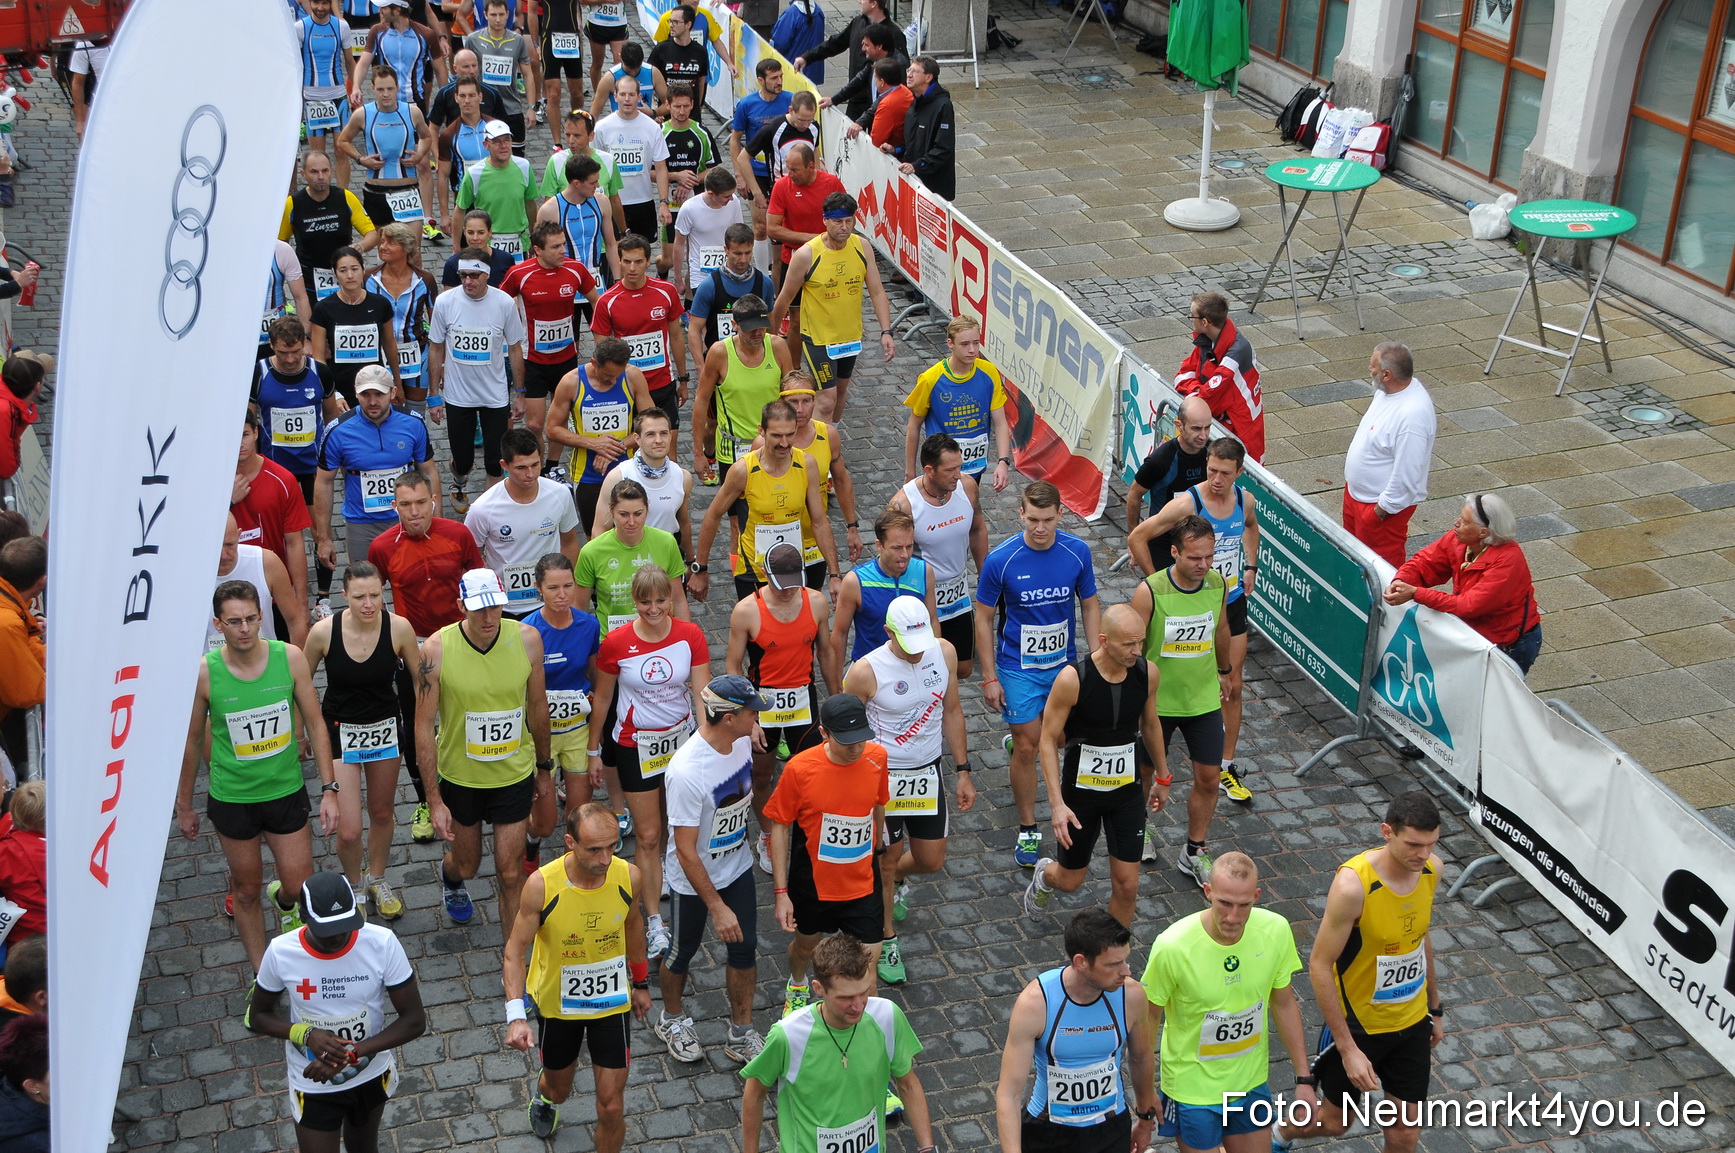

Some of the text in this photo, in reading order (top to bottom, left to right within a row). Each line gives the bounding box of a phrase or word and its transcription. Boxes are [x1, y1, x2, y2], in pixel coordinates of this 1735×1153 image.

[555, 38, 577, 48] 2059
[486, 62, 510, 74] 2707
[310, 106, 336, 118] 2028
[614, 152, 642, 164] 2005
[391, 197, 420, 212] 2042
[306, 222, 340, 232] Linzer
[340, 334, 375, 349] 2022
[539, 326, 570, 342] 2017
[454, 336, 490, 351] 2389
[630, 342, 661, 358] 2373
[634, 359, 656, 367] Thomas
[284, 417, 304, 433] 69
[592, 415, 620, 432] 323
[960, 444, 986, 461] 945
[938, 514, 966, 530] KLEBL
[1256, 540, 1312, 604] icherheit
[936, 581, 965, 606] 2232
[1020, 586, 1070, 602] SYSCAD
[1254, 568, 1293, 615] Event!
[1166, 617, 1208, 628] PARTL Neumarkt
[1040, 626, 1063, 635] Neumarkt
[1176, 625, 1207, 642] 227
[1026, 632, 1065, 654] 2430
[1174, 643, 1202, 652] Richard
[1264, 614, 1326, 679] Line: 09181 6352
[89, 424, 178, 889] Audi BKK
[1034, 656, 1060, 664] Andreas
[776, 692, 796, 710] 56
[250, 708, 280, 720] Neumarkt
[488, 714, 515, 722] Neumarkt
[548, 702, 581, 719] 235
[775, 712, 796, 722] Hynek
[894, 690, 944, 746] memmert
[243, 716, 280, 740] 177
[361, 720, 388, 730] Neumarkt
[478, 722, 512, 742] 152
[346, 728, 392, 748] 2252
[1378, 701, 1454, 766] Gebäude Service GmbH
[252, 740, 278, 752] Martin
[482, 744, 508, 756] Jürgen
[648, 736, 678, 756] 301
[1082, 748, 1102, 756] PARTL
[358, 750, 382, 760] Nicole
[1090, 757, 1126, 774] 210
[896, 778, 928, 797] 213
[1092, 777, 1121, 786] Thomas
[894, 800, 926, 809] Matthias
[824, 818, 872, 827] PARTL Neumarkt
[826, 825, 872, 846] 3318
[1536, 848, 1554, 872] die
[1554, 866, 1611, 923] verbinden
[586, 965, 616, 975] Neumarkt
[322, 974, 370, 985] Bayerisches
[568, 972, 620, 998] 2351
[1392, 985, 1416, 998] Stefan
[580, 1000, 610, 1009] Jürgen
[302, 1016, 359, 1027] PARTL Neumarkt
[1206, 1008, 1257, 1022] PARTL Neumarkt
[1216, 1016, 1254, 1042] 635
[1049, 1068, 1107, 1080] PARTL Neumarkt
[1056, 1075, 1112, 1102] 2002
[1071, 1104, 1100, 1114] Marco
[844, 1120, 872, 1137] Neumarkt
